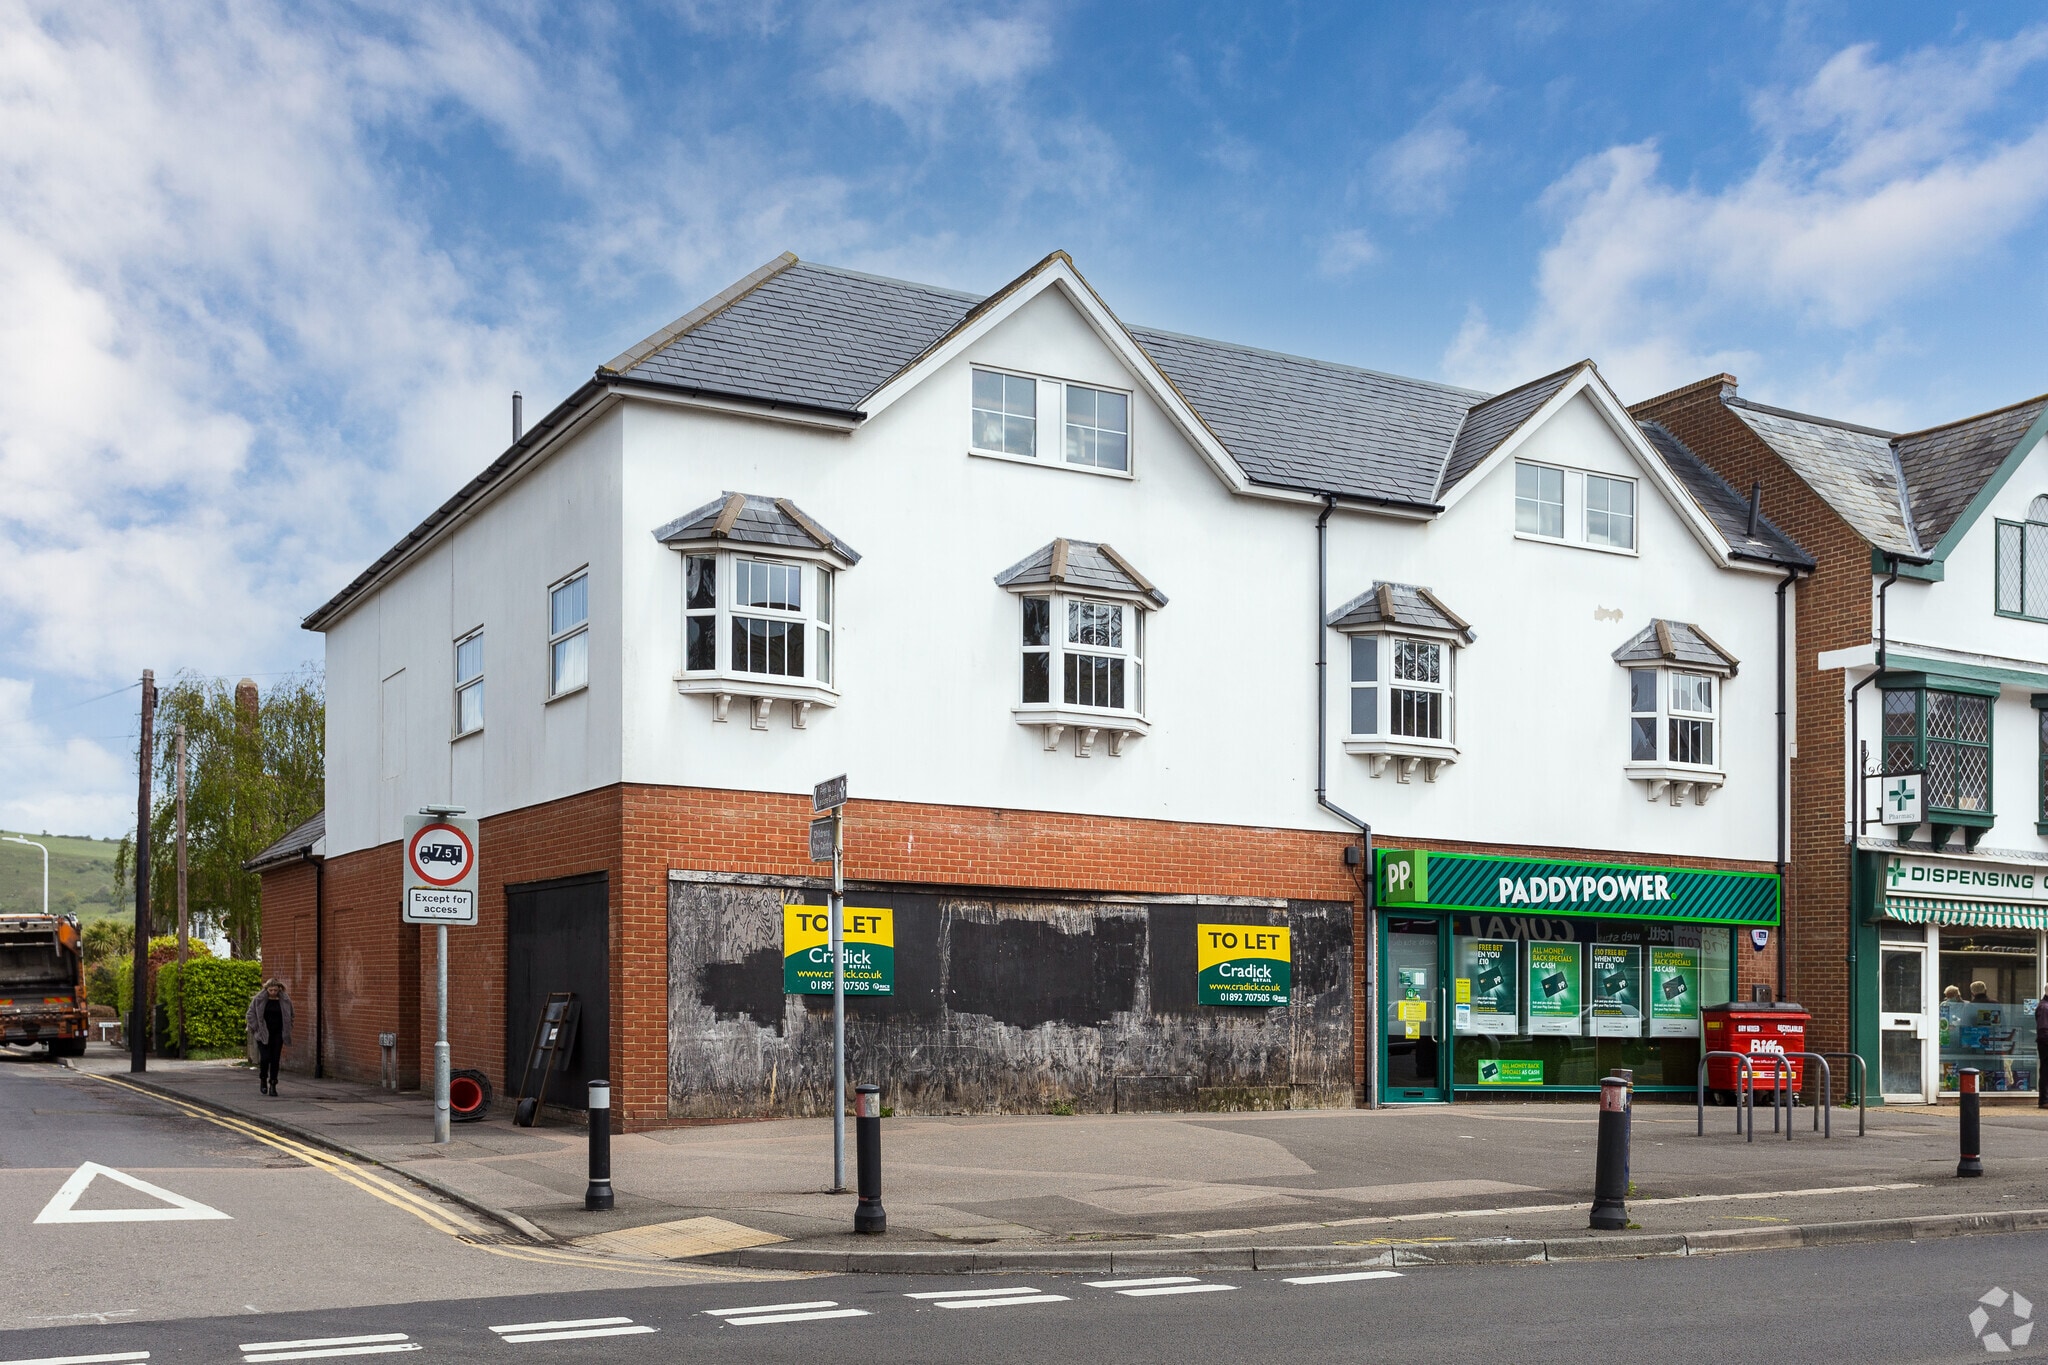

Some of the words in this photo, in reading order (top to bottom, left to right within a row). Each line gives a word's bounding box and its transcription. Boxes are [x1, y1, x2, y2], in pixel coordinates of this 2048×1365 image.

[1911, 866, 2034, 889] DISPENSING
[415, 893, 450, 904] Except
[453, 895, 467, 904] for
[796, 914, 828, 932] TO
[1208, 932, 1238, 948] TO
[1244, 933, 1280, 950] LET
[797, 970, 882, 979] www.crick.co.uk
[1219, 963, 1272, 978] Cradick
[1209, 982, 1280, 992] www.cradick.co.uk
[1220, 992, 1242, 1002] 01892
[1244, 993, 1270, 1002] 707505
